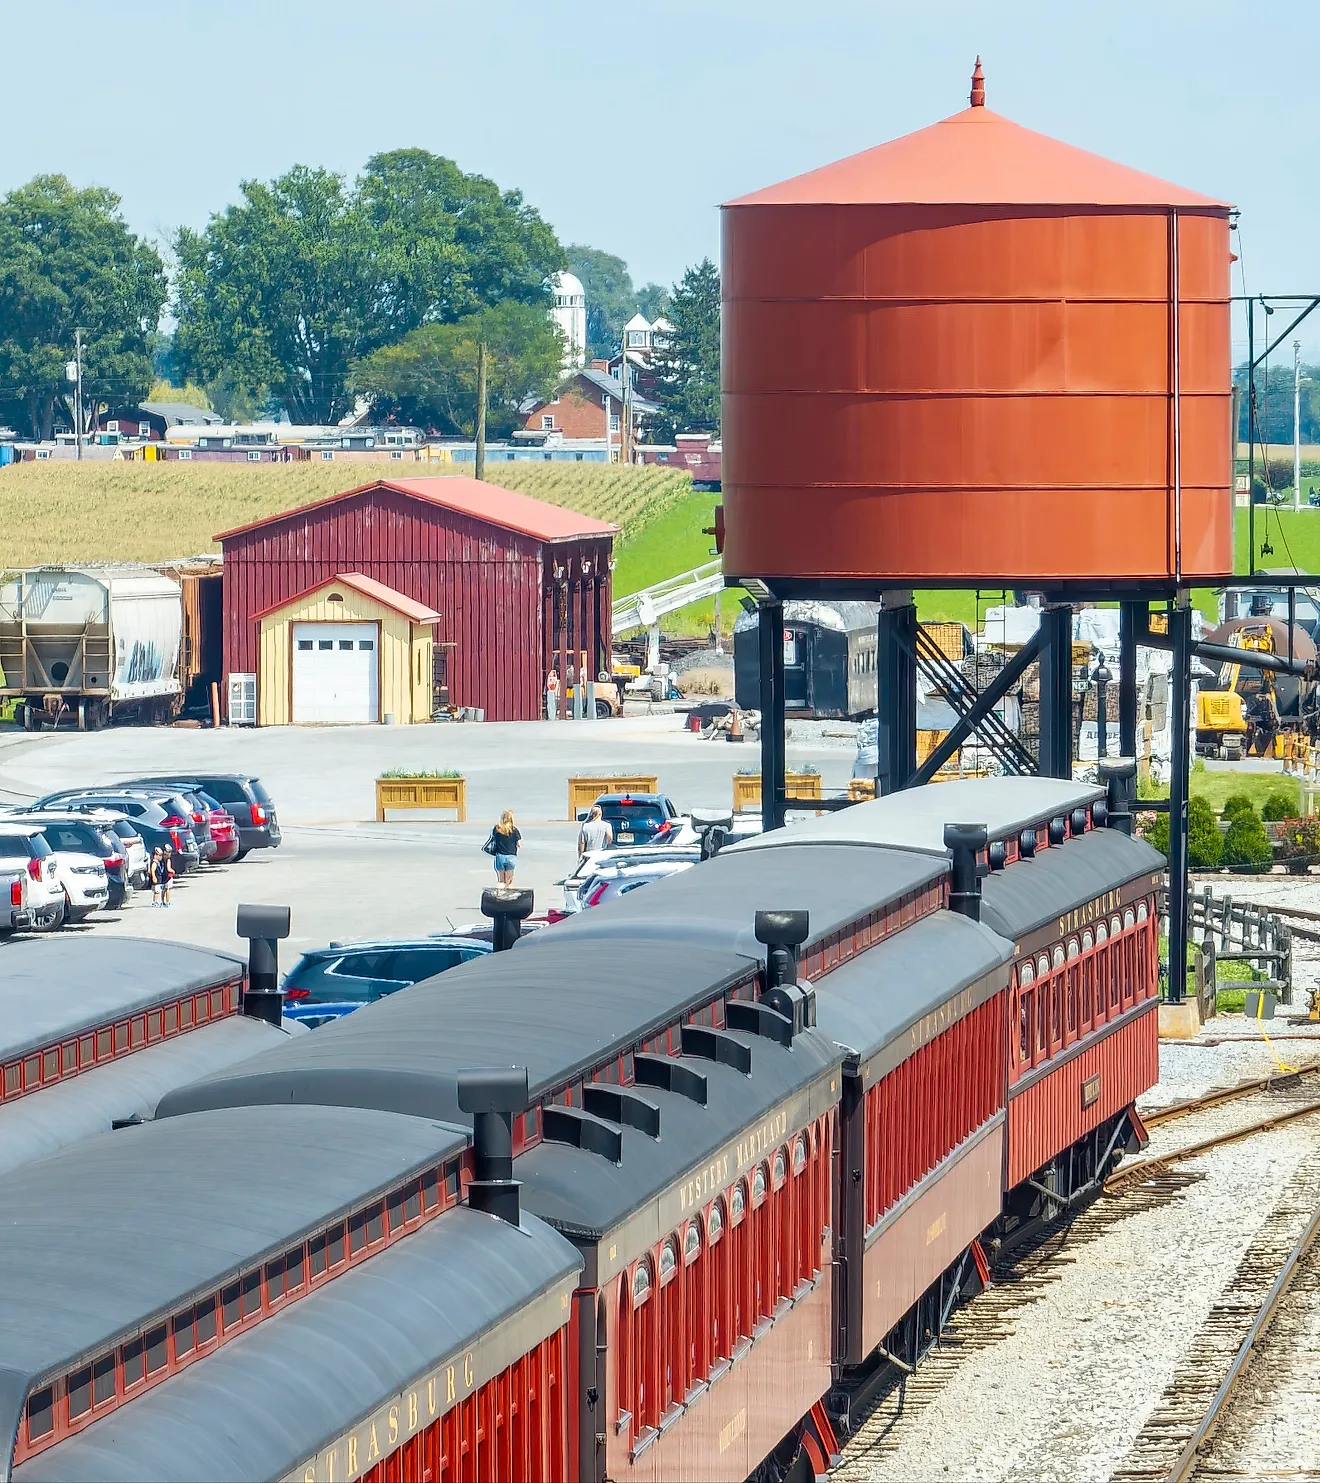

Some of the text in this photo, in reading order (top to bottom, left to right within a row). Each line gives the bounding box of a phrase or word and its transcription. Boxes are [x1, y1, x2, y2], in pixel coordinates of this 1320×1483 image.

[1059, 886, 1122, 937] STRASBURG
[680, 1111, 788, 1212] WESTERN MARYLAND
